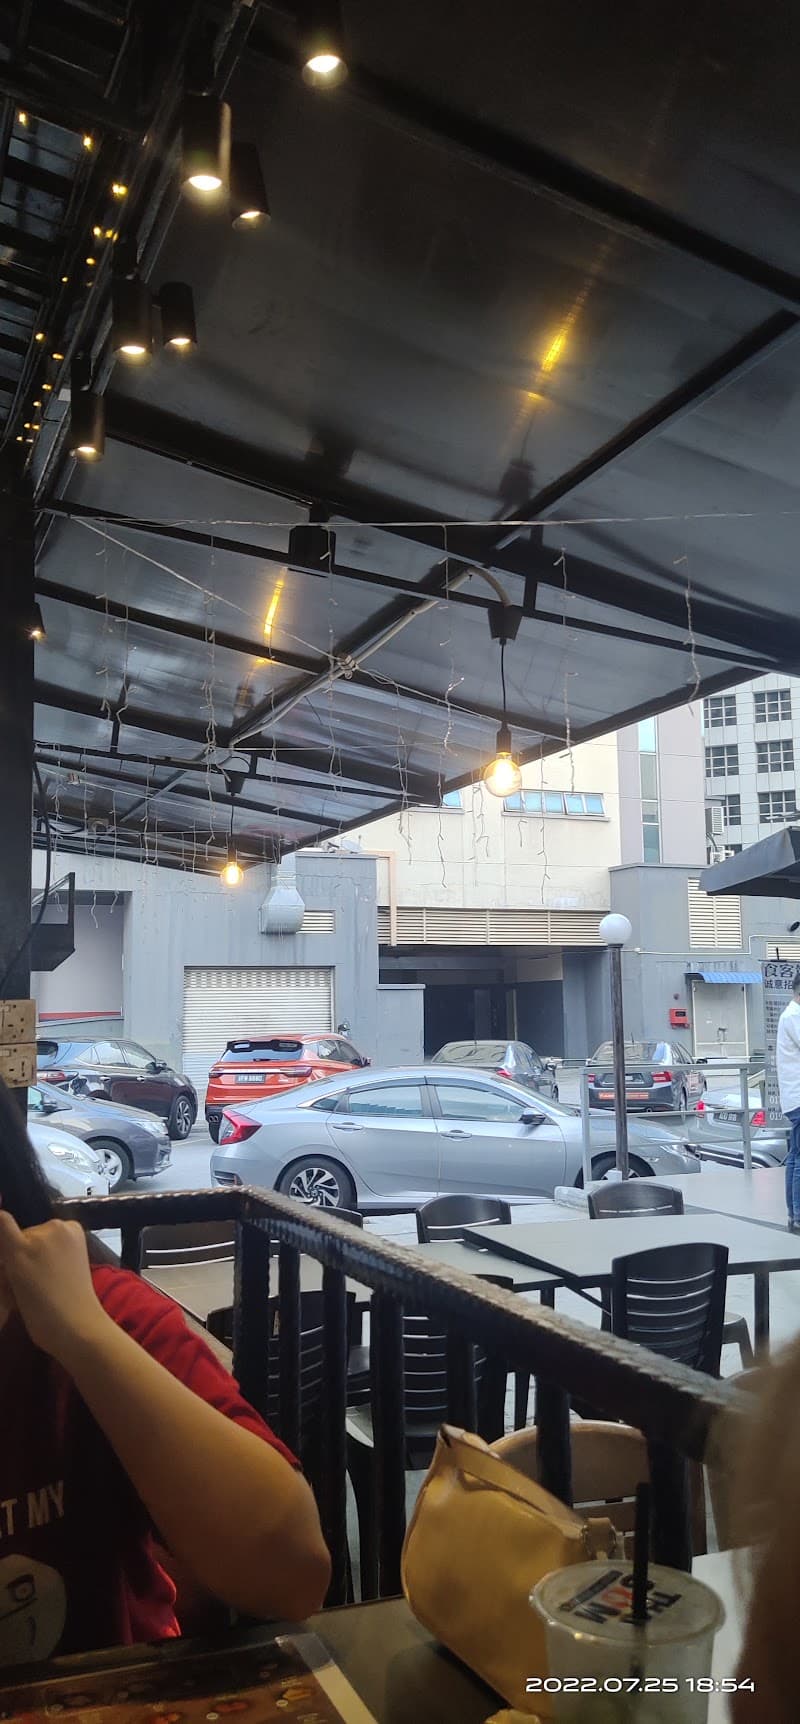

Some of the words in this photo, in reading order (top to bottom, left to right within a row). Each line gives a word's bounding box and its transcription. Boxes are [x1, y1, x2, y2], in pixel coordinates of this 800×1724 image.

[764, 962, 800, 978] 食客
[0, 1498, 18, 1540] T
[27, 1480, 65, 1529] MY
